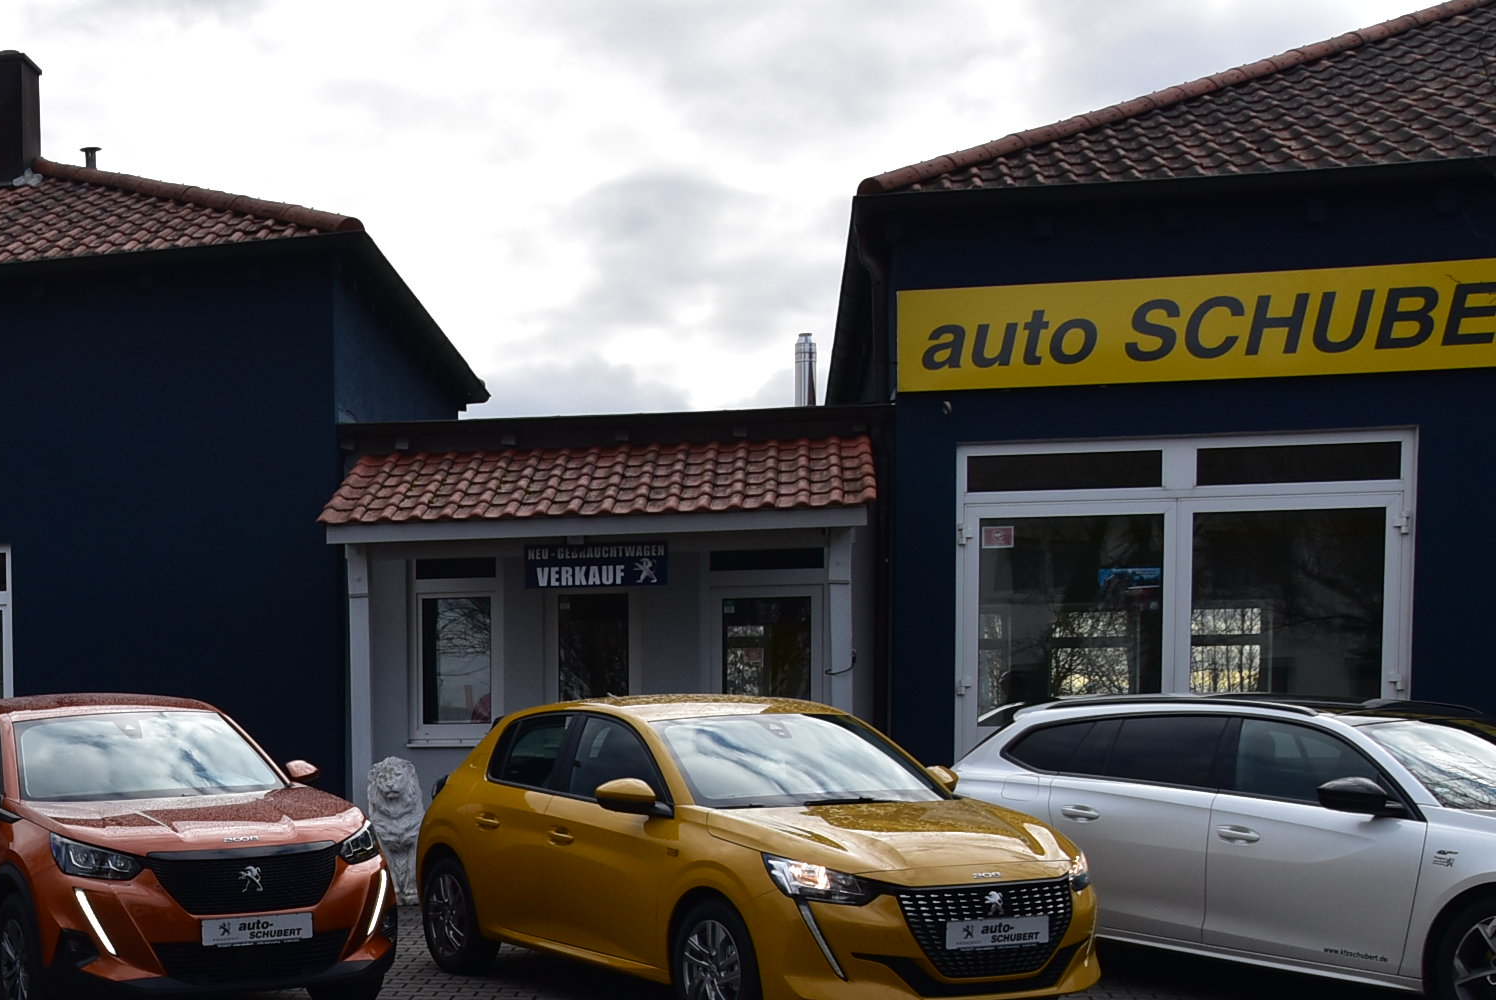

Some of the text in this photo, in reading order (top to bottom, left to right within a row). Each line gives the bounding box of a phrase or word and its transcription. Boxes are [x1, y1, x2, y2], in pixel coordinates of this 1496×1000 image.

[920, 282, 1496, 371] auto SCHUBE
[527, 548, 549, 560] NEU
[557, 545, 665, 560] GEBRAUCHTWAGEN
[536, 565, 625, 587] VERKAUF
[238, 919, 274, 931] auto-
[981, 922, 1015, 935] auto-
[249, 927, 302, 939] SCHUBERT
[991, 931, 1040, 943] SCHUBERT
